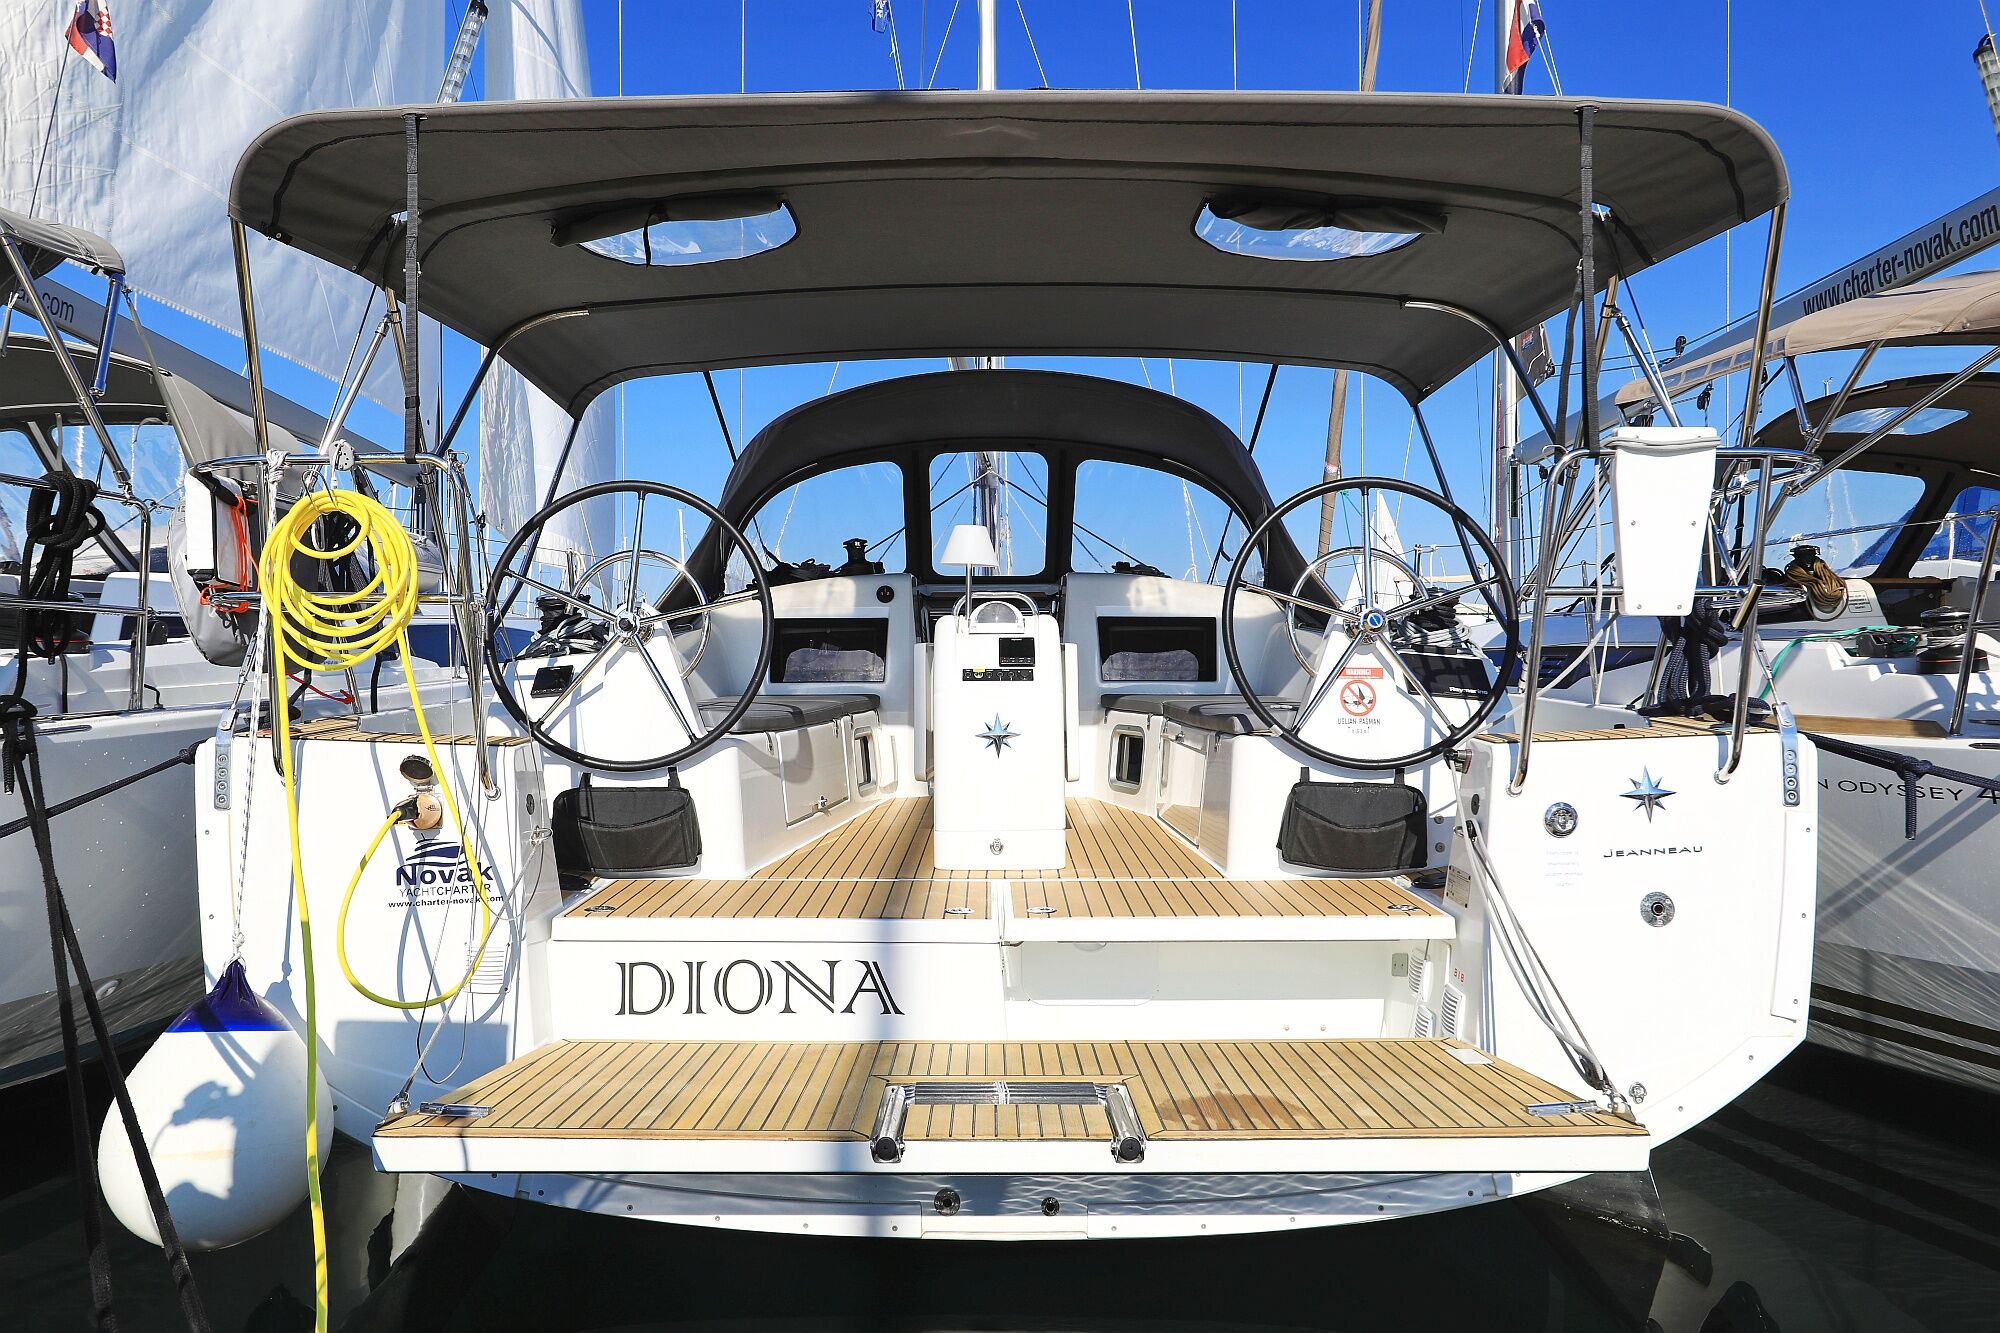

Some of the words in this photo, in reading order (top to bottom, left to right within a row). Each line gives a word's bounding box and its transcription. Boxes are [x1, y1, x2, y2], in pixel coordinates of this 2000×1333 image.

[1803, 204, 2000, 316] www.charter-novak.com
[1838, 780, 1963, 801] ODYSSEY
[1603, 846, 1703, 858] JEANNEAU
[396, 861, 494, 886] Novak
[400, 883, 492, 898] YACHTCHARTR
[388, 895, 504, 908] www.charter-novakom
[614, 958, 906, 1016] DIONA
